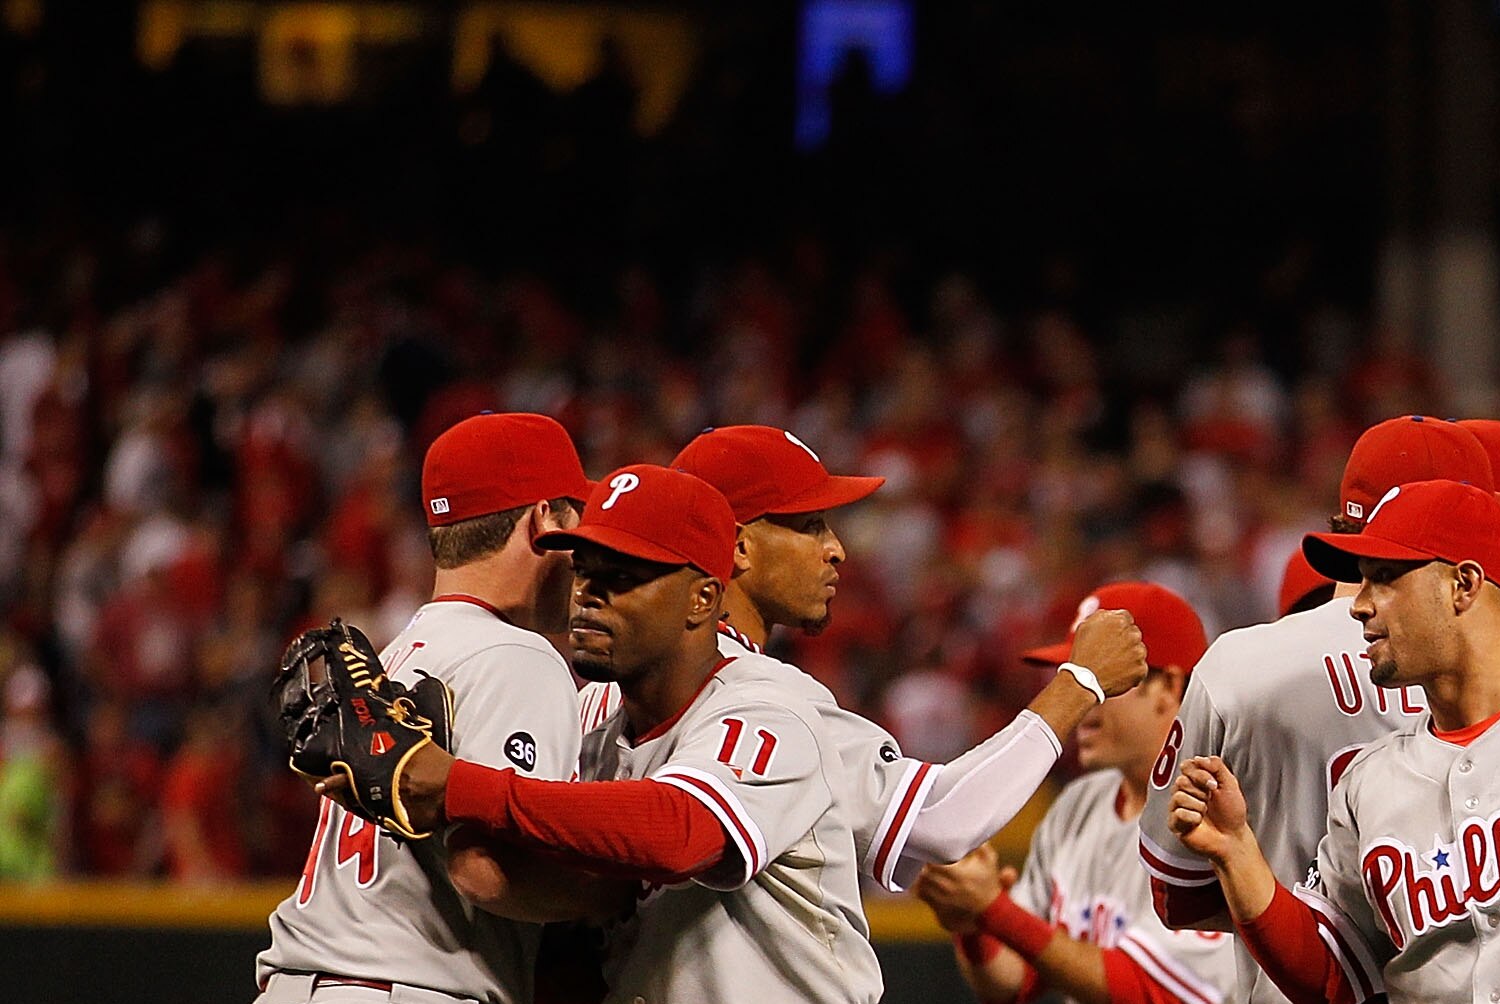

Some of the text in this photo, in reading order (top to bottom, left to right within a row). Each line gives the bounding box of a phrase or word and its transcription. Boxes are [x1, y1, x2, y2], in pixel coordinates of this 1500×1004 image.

[600, 473, 640, 510] P
[511, 738, 534, 765] 36
[717, 716, 779, 777] 11
